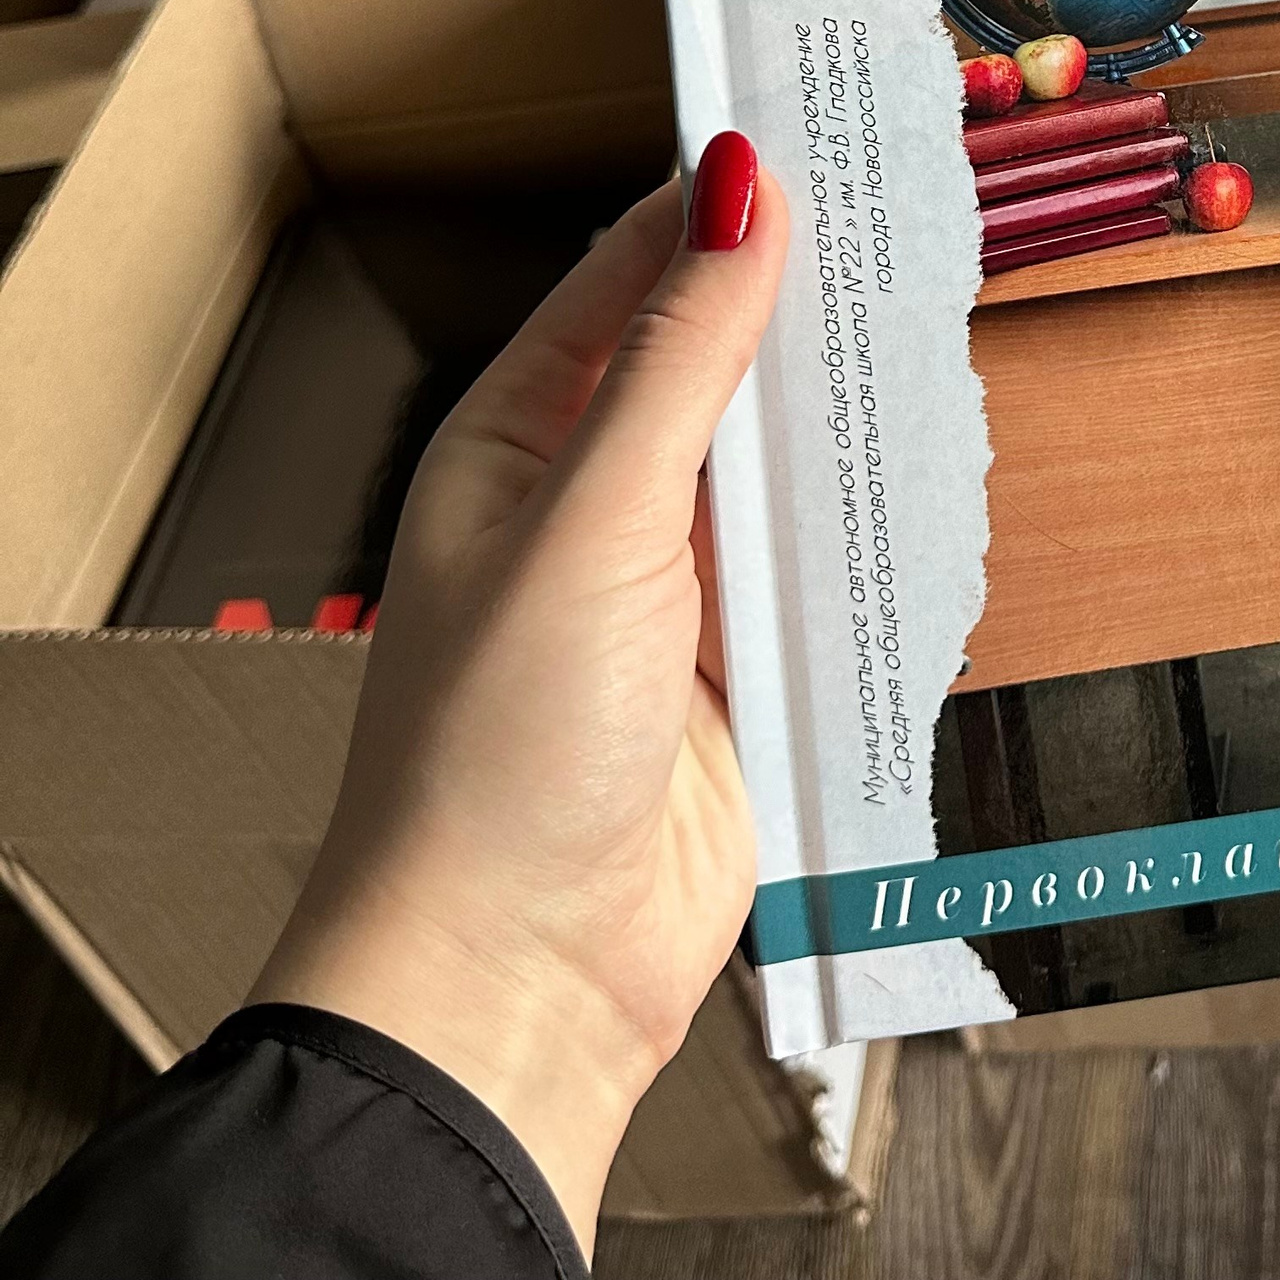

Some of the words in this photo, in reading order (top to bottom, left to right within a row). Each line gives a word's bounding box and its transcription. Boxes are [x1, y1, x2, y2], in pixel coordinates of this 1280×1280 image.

[794, 22, 829, 163] учреждение
[822, 17, 849, 123] Гладкова
[850, 19, 884, 200] Новороссийска
[827, 130, 852, 170] Ф.В.
[839, 179, 857, 210] им.
[837, 236, 865, 295] №22
[870, 206, 896, 294] города
[809, 169, 852, 450] общеобразовательное
[850, 301, 873, 377] школа
[836, 458, 867, 604] автономное
[858, 383, 902, 671] общеобразовательная
[851, 612, 890, 806] Муниципальное
[887, 678, 916, 796] «Средняя
